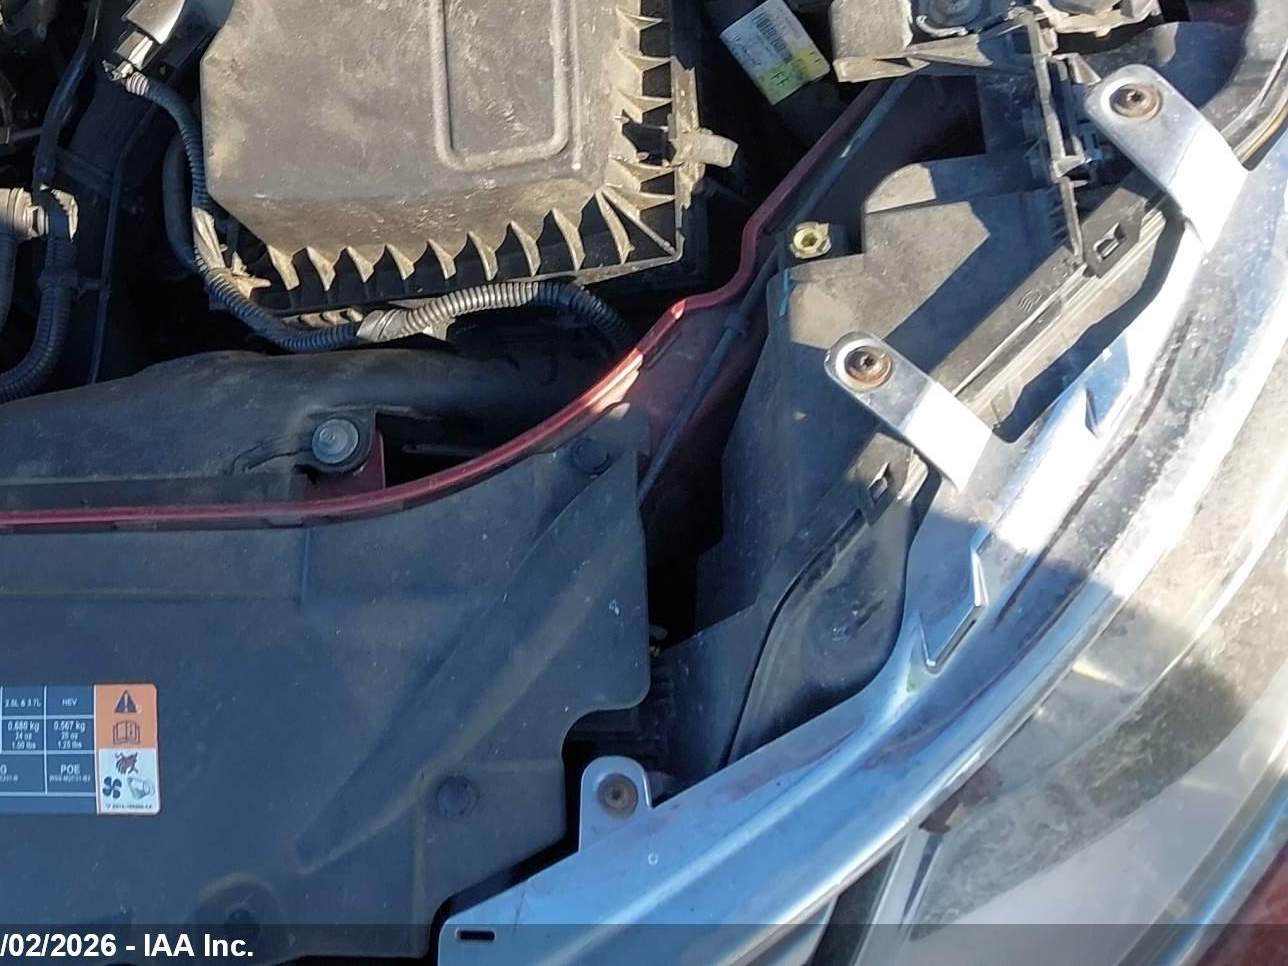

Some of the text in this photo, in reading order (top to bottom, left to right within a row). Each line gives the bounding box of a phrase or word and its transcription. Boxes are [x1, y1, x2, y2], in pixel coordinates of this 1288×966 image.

[61, 698, 78, 707] HEV
[29, 720, 40, 733] kg
[75, 720, 86, 733] kg
[60, 763, 81, 775] POE
